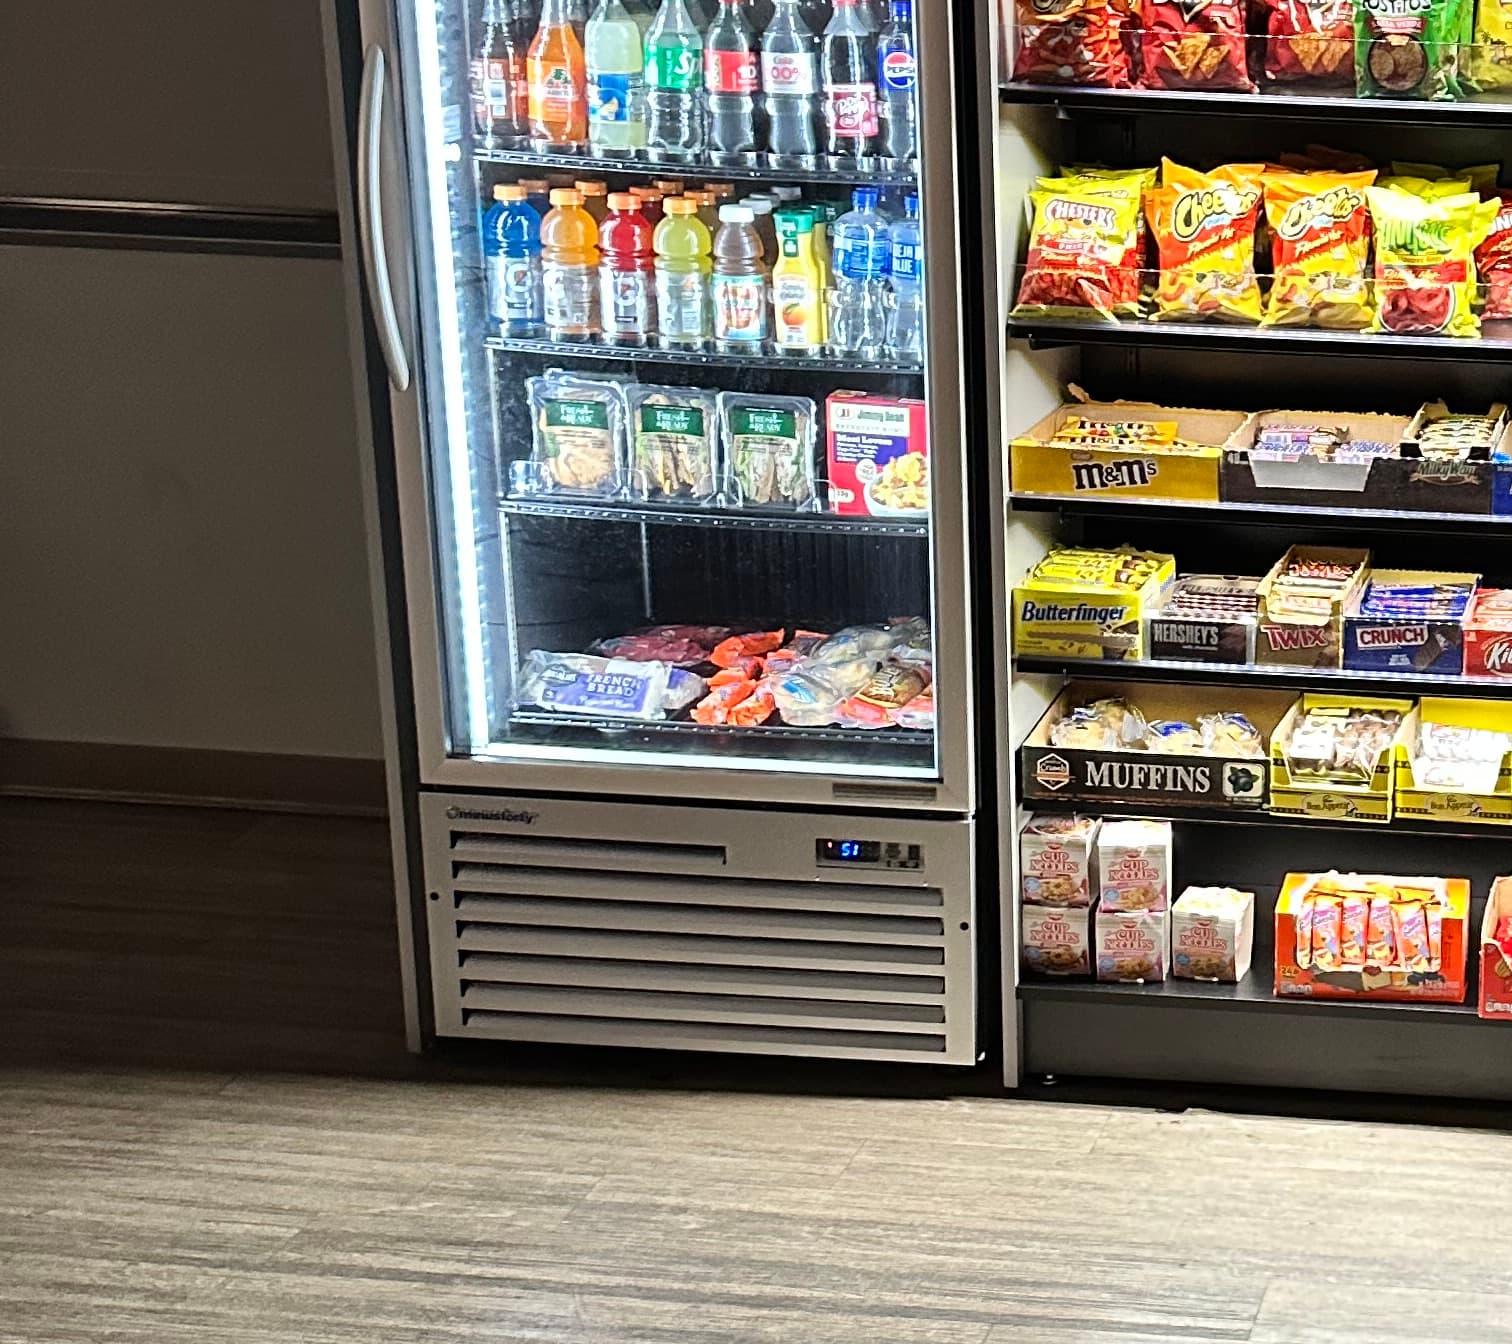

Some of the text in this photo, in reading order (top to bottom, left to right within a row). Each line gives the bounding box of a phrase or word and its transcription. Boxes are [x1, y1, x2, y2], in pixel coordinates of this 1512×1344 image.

[1021, 600, 1127, 625] Butterfinger
[1154, 622, 1220, 646] HERSHEY'S
[1260, 624, 1329, 651] TWIX
[1359, 627, 1426, 646] CRUNCH
[586, 673, 642, 689] FRENCH
[586, 683, 635, 697] BREAD
[1085, 760, 1211, 794] MUFFINS
[1040, 851, 1069, 862] CUP
[1030, 860, 1079, 873] NOODLES
[1119, 859, 1149, 870] CUP
[1108, 868, 1160, 881] NOODLES
[1041, 921, 1070, 932] CUP
[1191, 927, 1218, 938] CUP
[1030, 930, 1080, 944] NOODLES
[1115, 929, 1145, 940] CUP
[1104, 938, 1155, 951] NOODLES
[1179, 935, 1228, 949] NOODLES
